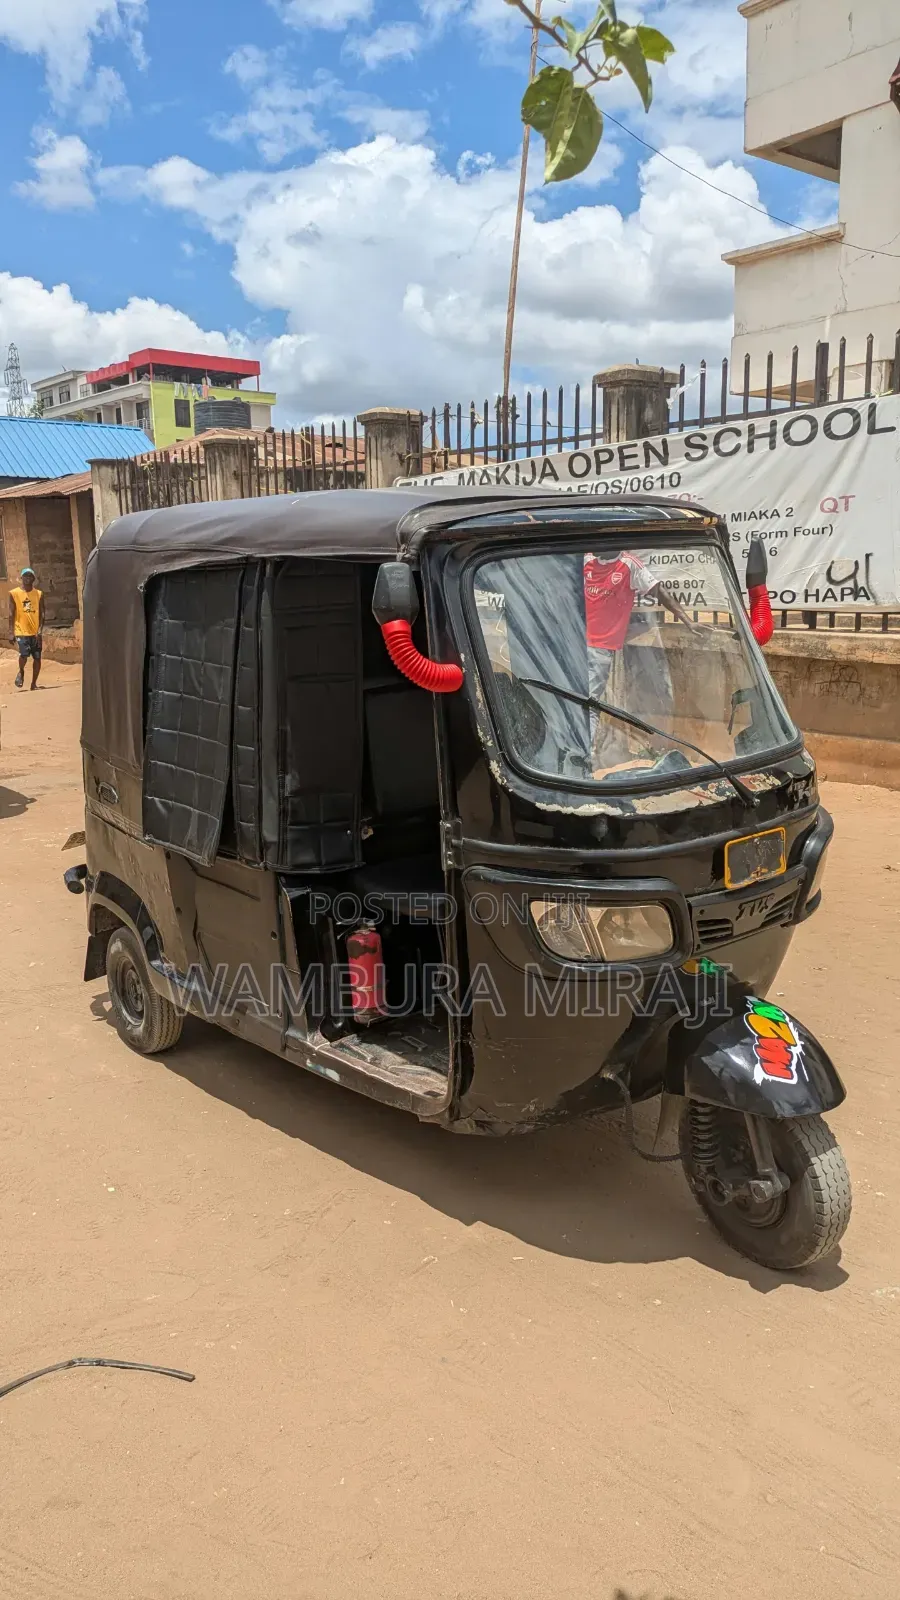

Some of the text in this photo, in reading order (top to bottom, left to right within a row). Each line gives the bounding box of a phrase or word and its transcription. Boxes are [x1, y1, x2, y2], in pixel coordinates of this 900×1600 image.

[458, 402, 897, 486] MAKIJA OPEN SCHOOL
[819, 494, 856, 514] QT
[730, 508, 781, 523] MIAKA
[785, 506, 794, 518] 2
[745, 530, 788, 543] (Form
[793, 523, 834, 538] Four)
[648, 553, 695, 565] KIDATO
[769, 546, 778, 557] 6
[683, 579, 706, 589] 807
[804, 586, 871, 604] HAPA
